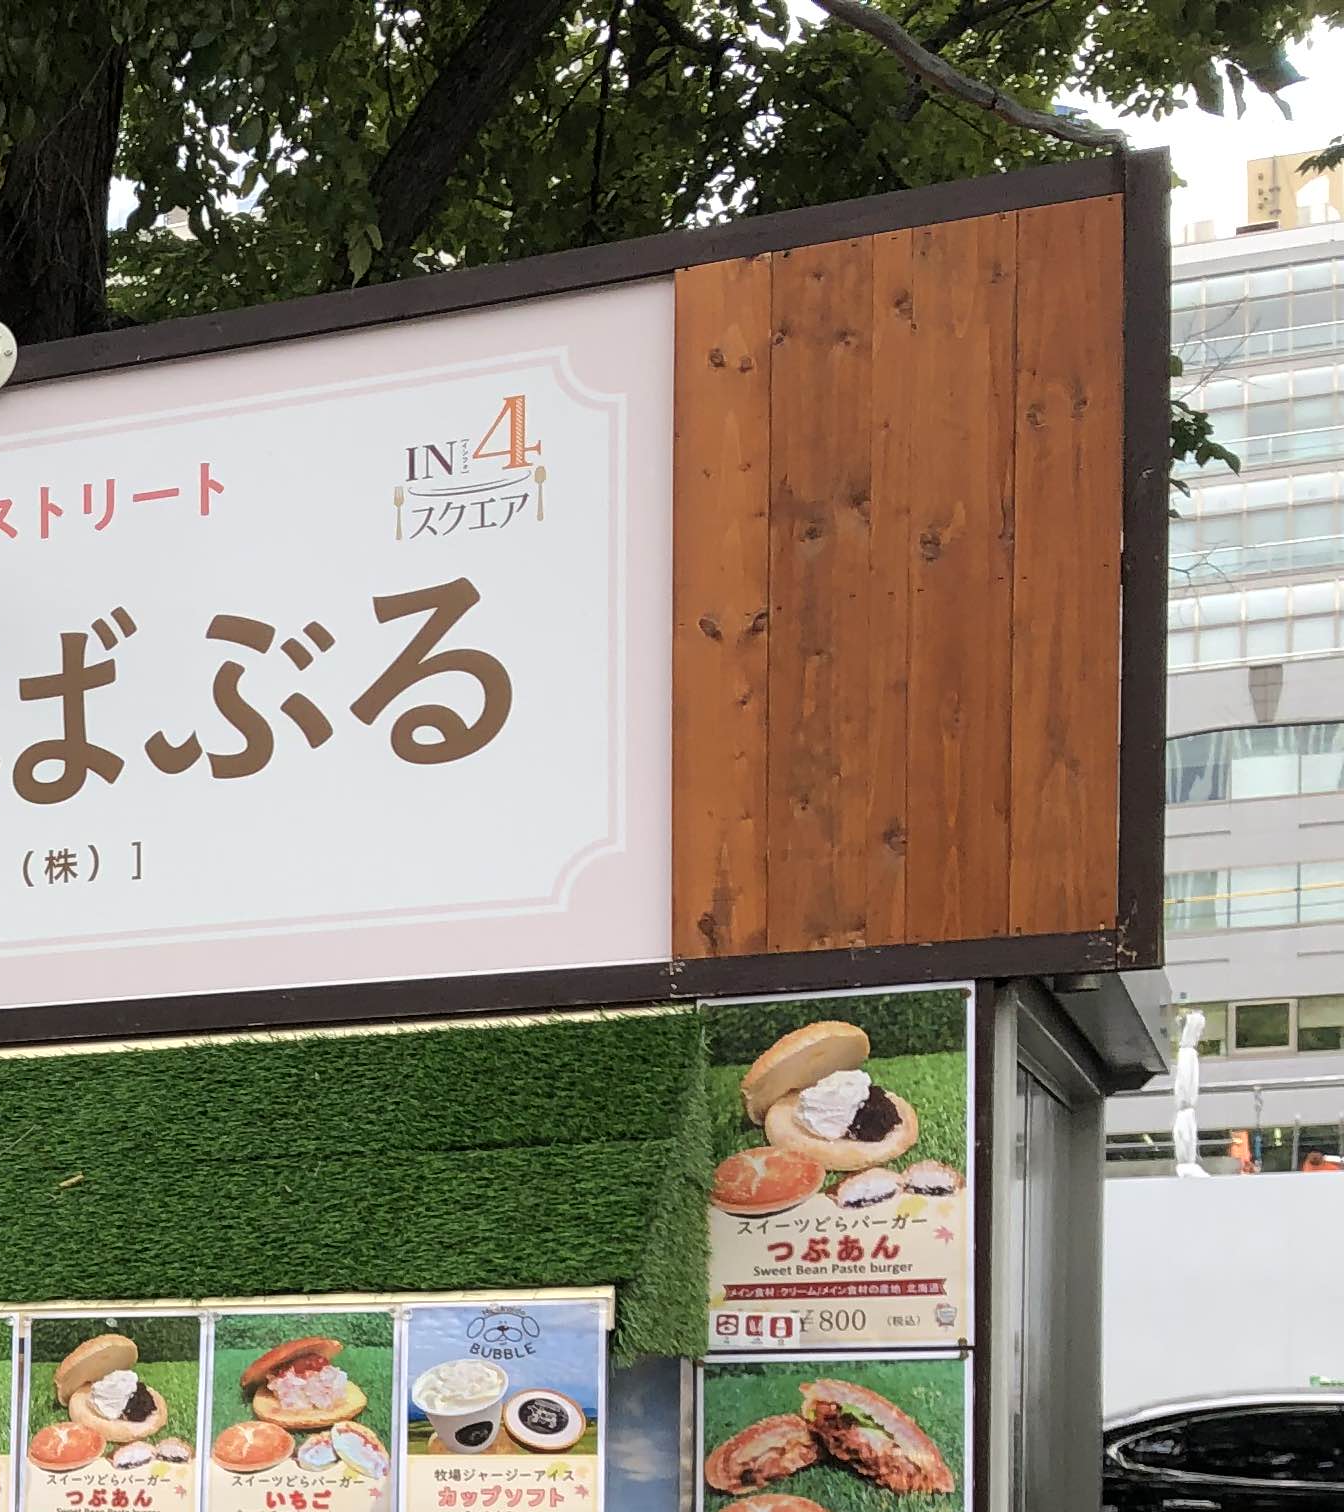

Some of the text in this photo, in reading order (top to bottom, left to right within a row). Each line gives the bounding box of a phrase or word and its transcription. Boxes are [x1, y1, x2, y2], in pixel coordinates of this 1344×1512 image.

[405, 394, 542, 482] IN 4
[409, 492, 530, 540] スクエア
[737, 1214, 928, 1236] スイーツどらバーガー
[767, 1234, 901, 1264] つぶあん
[753, 1262, 913, 1277] Sweet Bean Paste burger
[792, 1308, 867, 1332] ¥800
[469, 1342, 537, 1360] BUBBLE
[46, 1473, 171, 1486] スイーツどらバーガー
[232, 1475, 365, 1488] スイーツどらバーガー
[434, 1468, 575, 1482] 牧場ジャージーアイス
[65, 1489, 153, 1508] つぶあん
[266, 1490, 333, 1510] いちご
[438, 1486, 565, 1508] カップソフト
